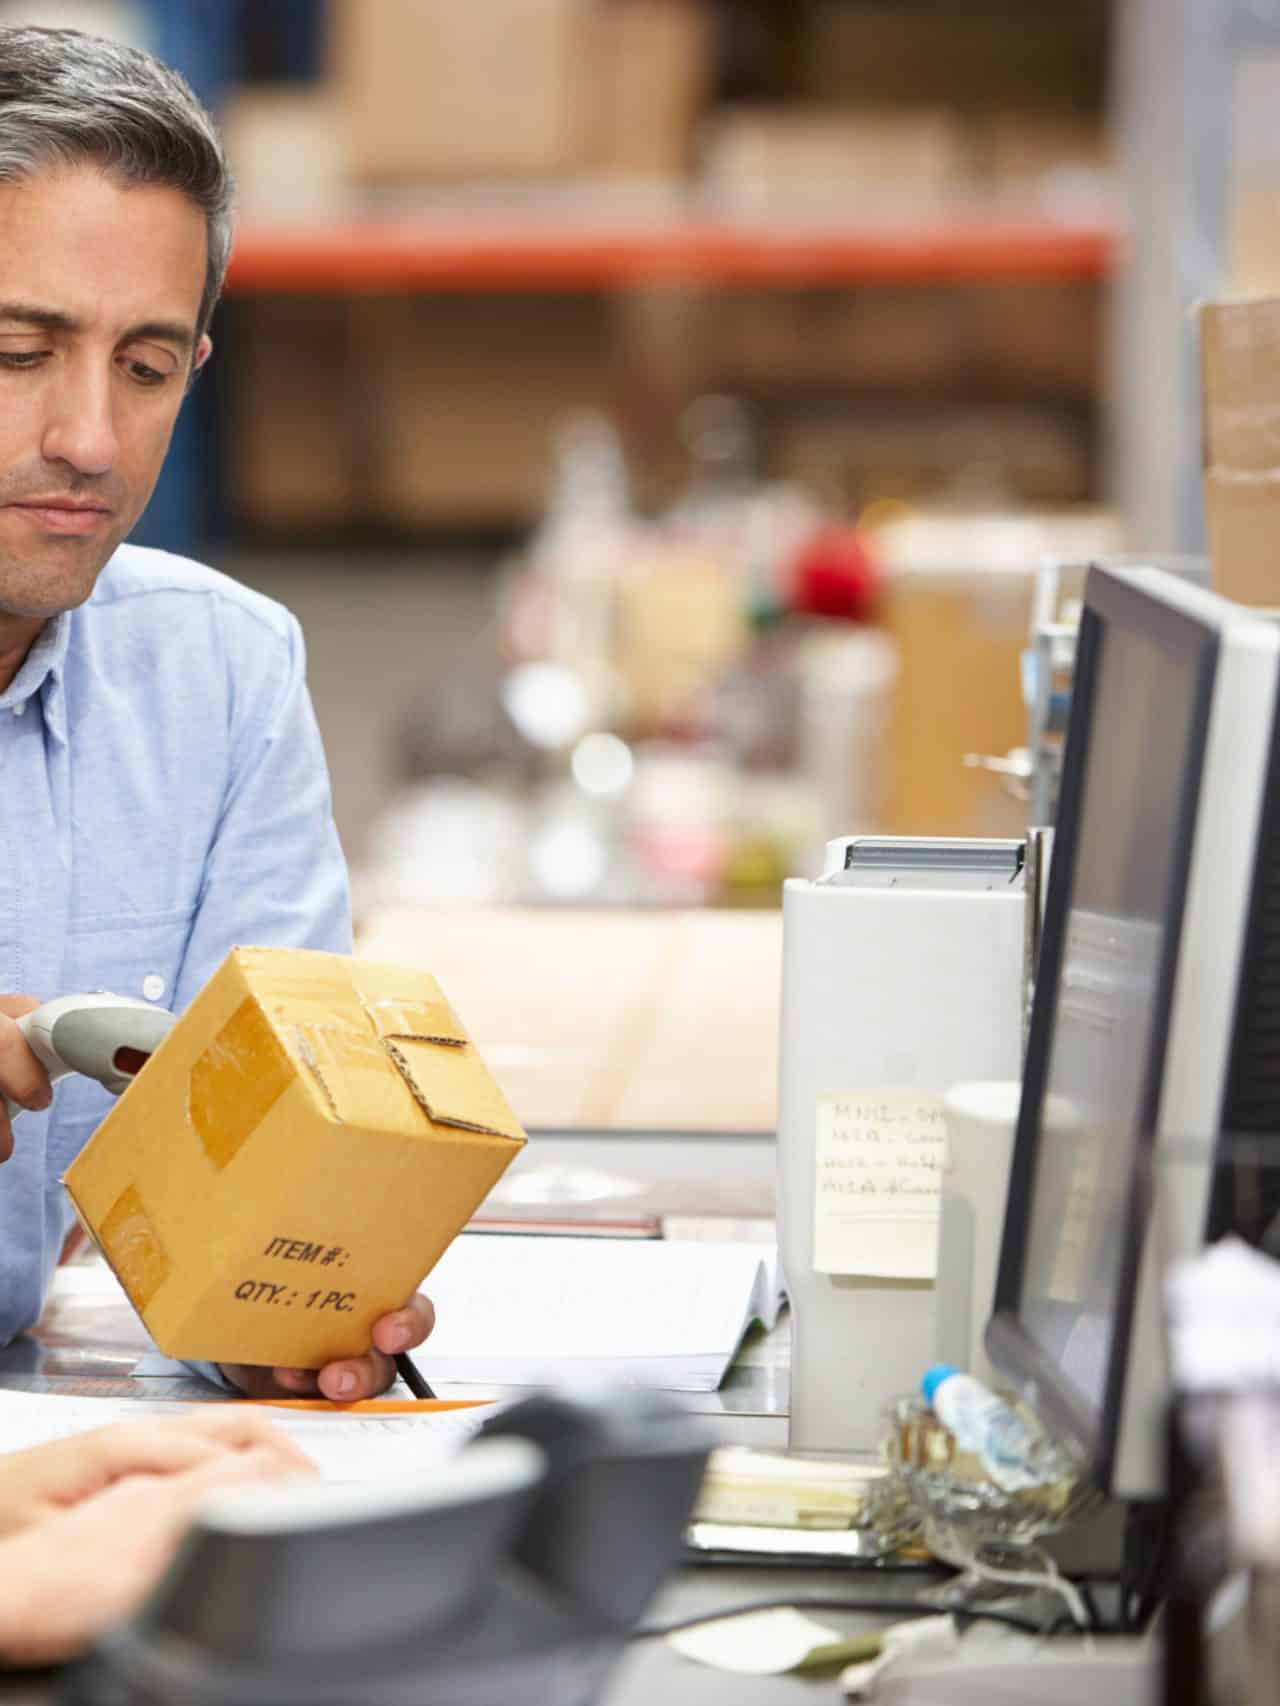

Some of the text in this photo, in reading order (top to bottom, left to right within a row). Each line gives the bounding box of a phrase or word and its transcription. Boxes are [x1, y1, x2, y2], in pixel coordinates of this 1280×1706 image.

[264, 1237, 324, 1264] ITEM
[306, 1289, 322, 1309] 1
[320, 1290, 356, 1312] PC.
